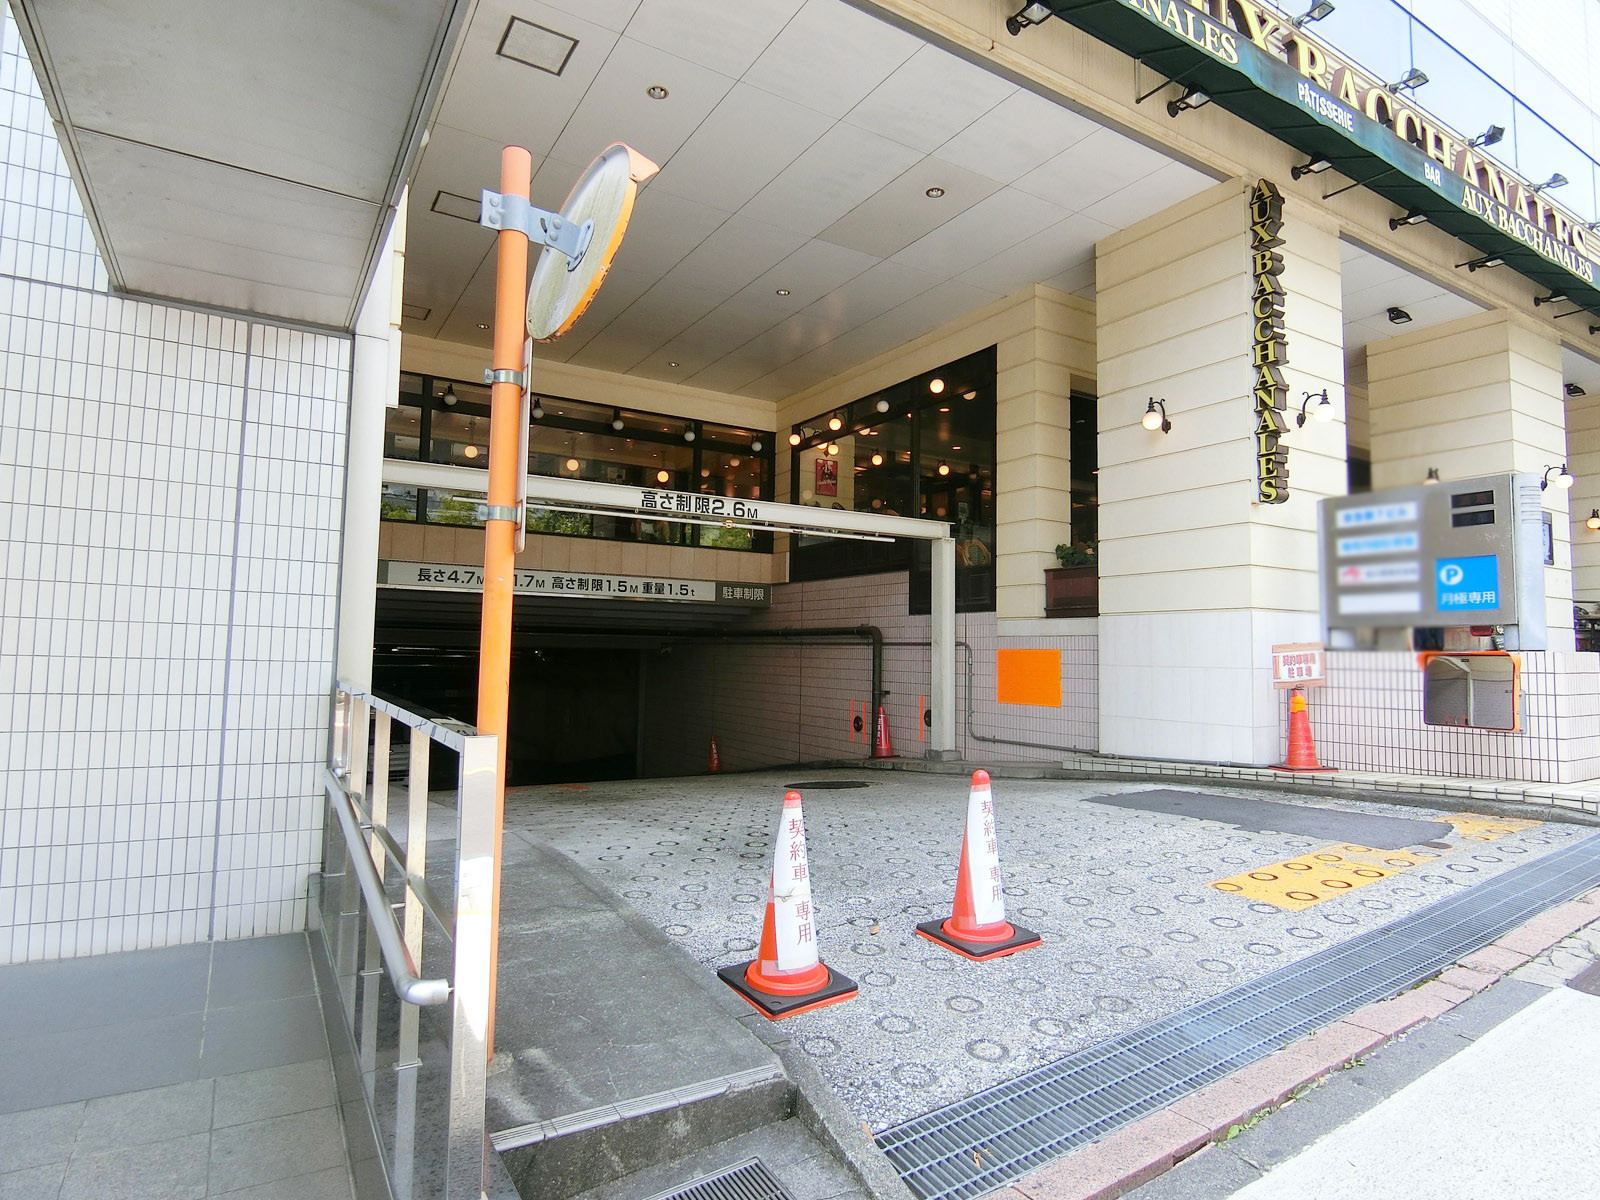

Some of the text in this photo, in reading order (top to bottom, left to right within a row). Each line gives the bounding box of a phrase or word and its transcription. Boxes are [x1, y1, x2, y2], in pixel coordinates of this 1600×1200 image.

[1128, 0, 1239, 65] NALES
[1297, 82, 1354, 133] PÂTISSERIE
[1424, 162, 1442, 187] BAR
[1461, 185, 1594, 284] AUX BACCHANALES
[1250, 178, 1281, 502] AUX BACCHANALES
[722, 586, 765, 601] 駐車制限
[1441, 590, 1496, 605] 月極専用
